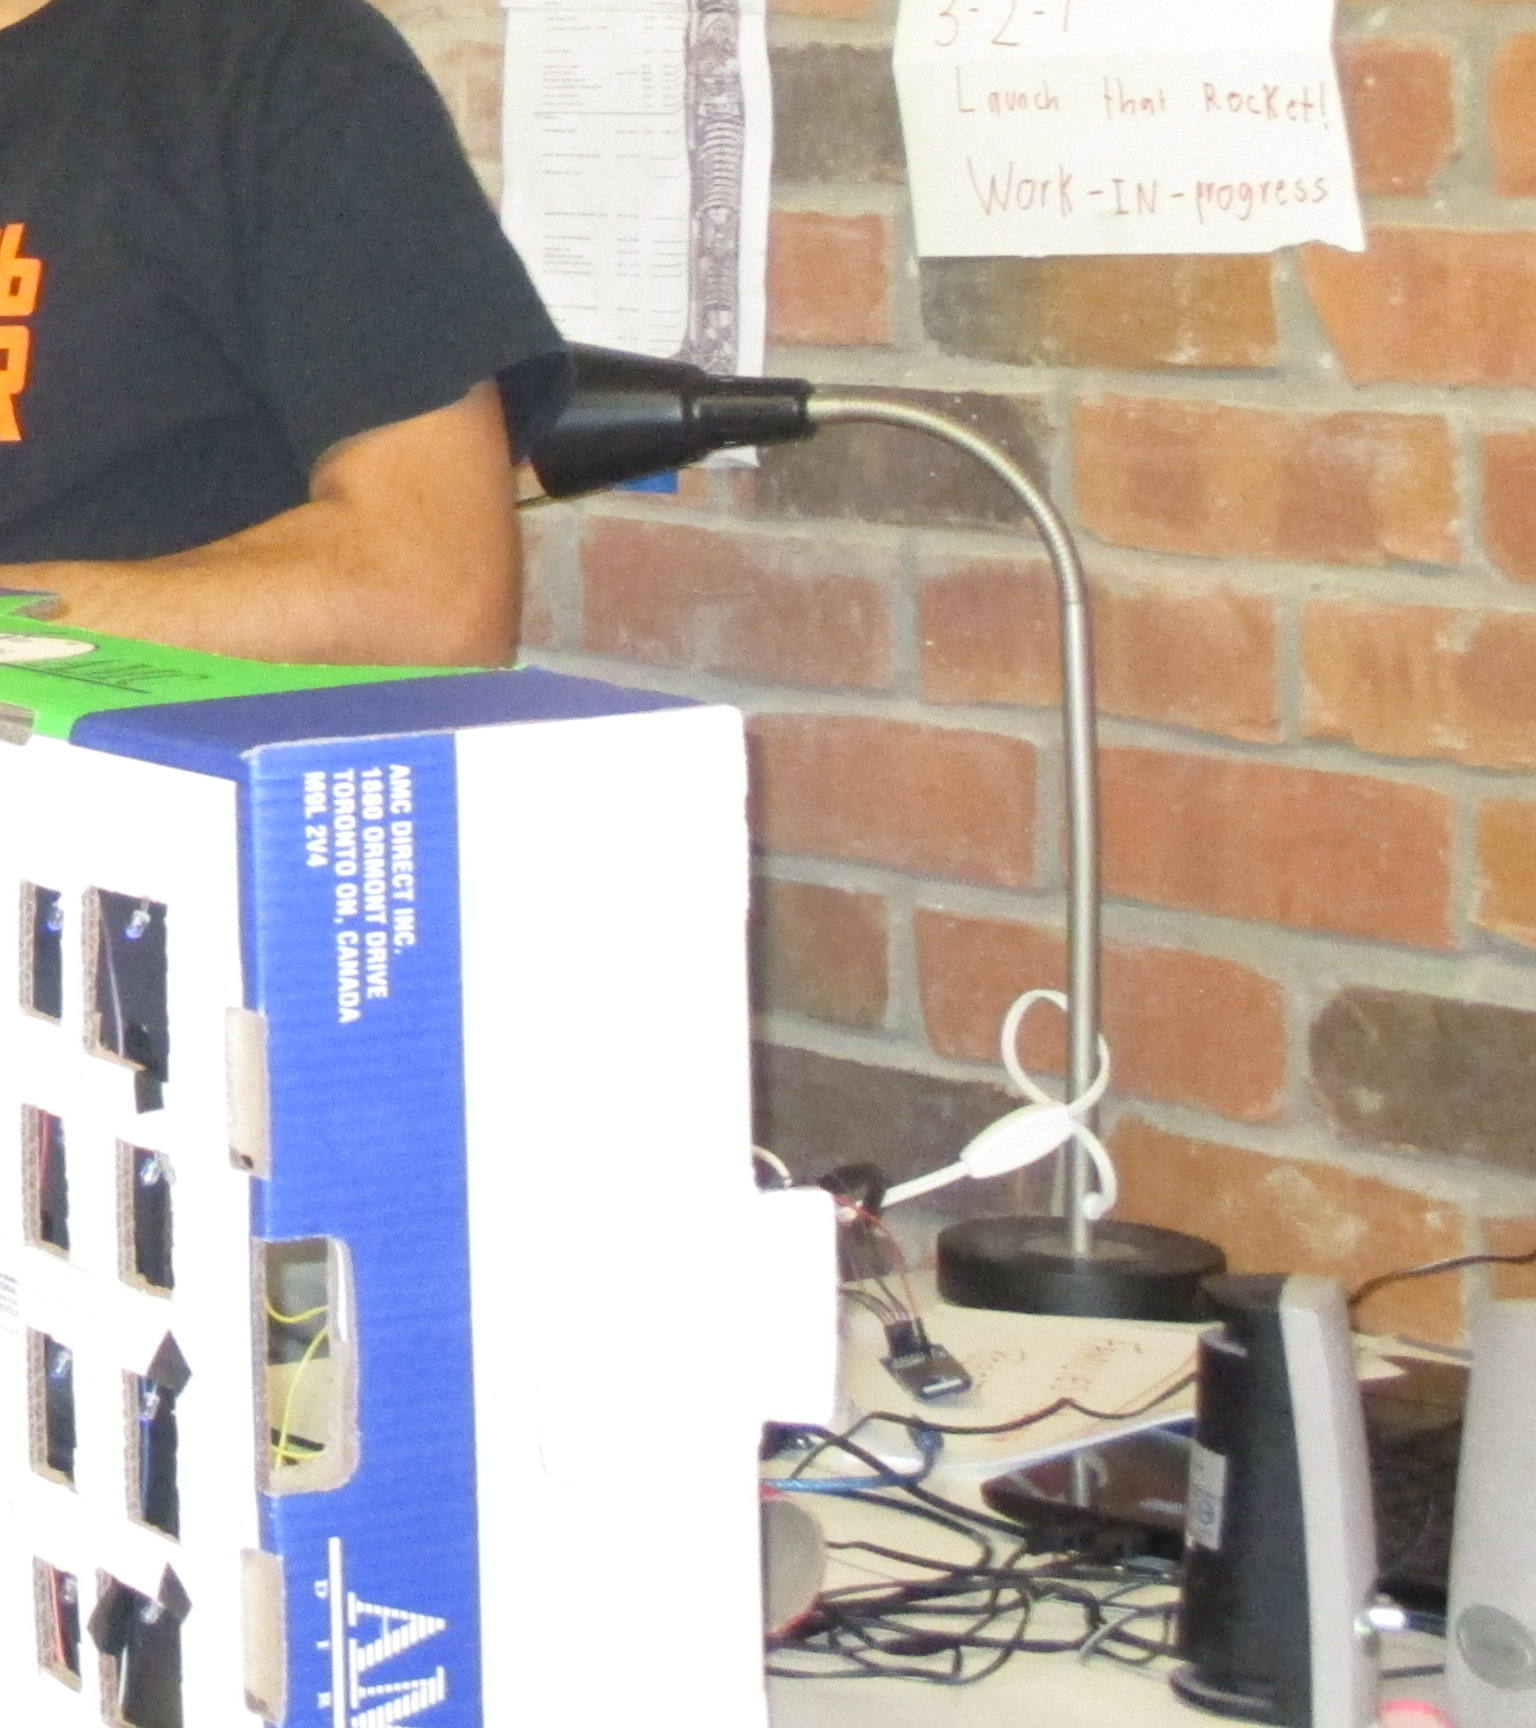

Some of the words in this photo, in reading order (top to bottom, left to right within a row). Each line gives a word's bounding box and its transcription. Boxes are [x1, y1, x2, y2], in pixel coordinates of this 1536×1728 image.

[954, 65, 1061, 117] Launch
[1102, 75, 1167, 120] that
[332, 768, 358, 877] TORONTO
[389, 763, 413, 814] AMC
[305, 824, 329, 868] 2V4
[362, 825, 387, 925] ORMONT
[390, 820, 415, 902] DIRECT
[336, 930, 362, 1024] CANADA
[365, 930, 389, 1000] DRIVE
